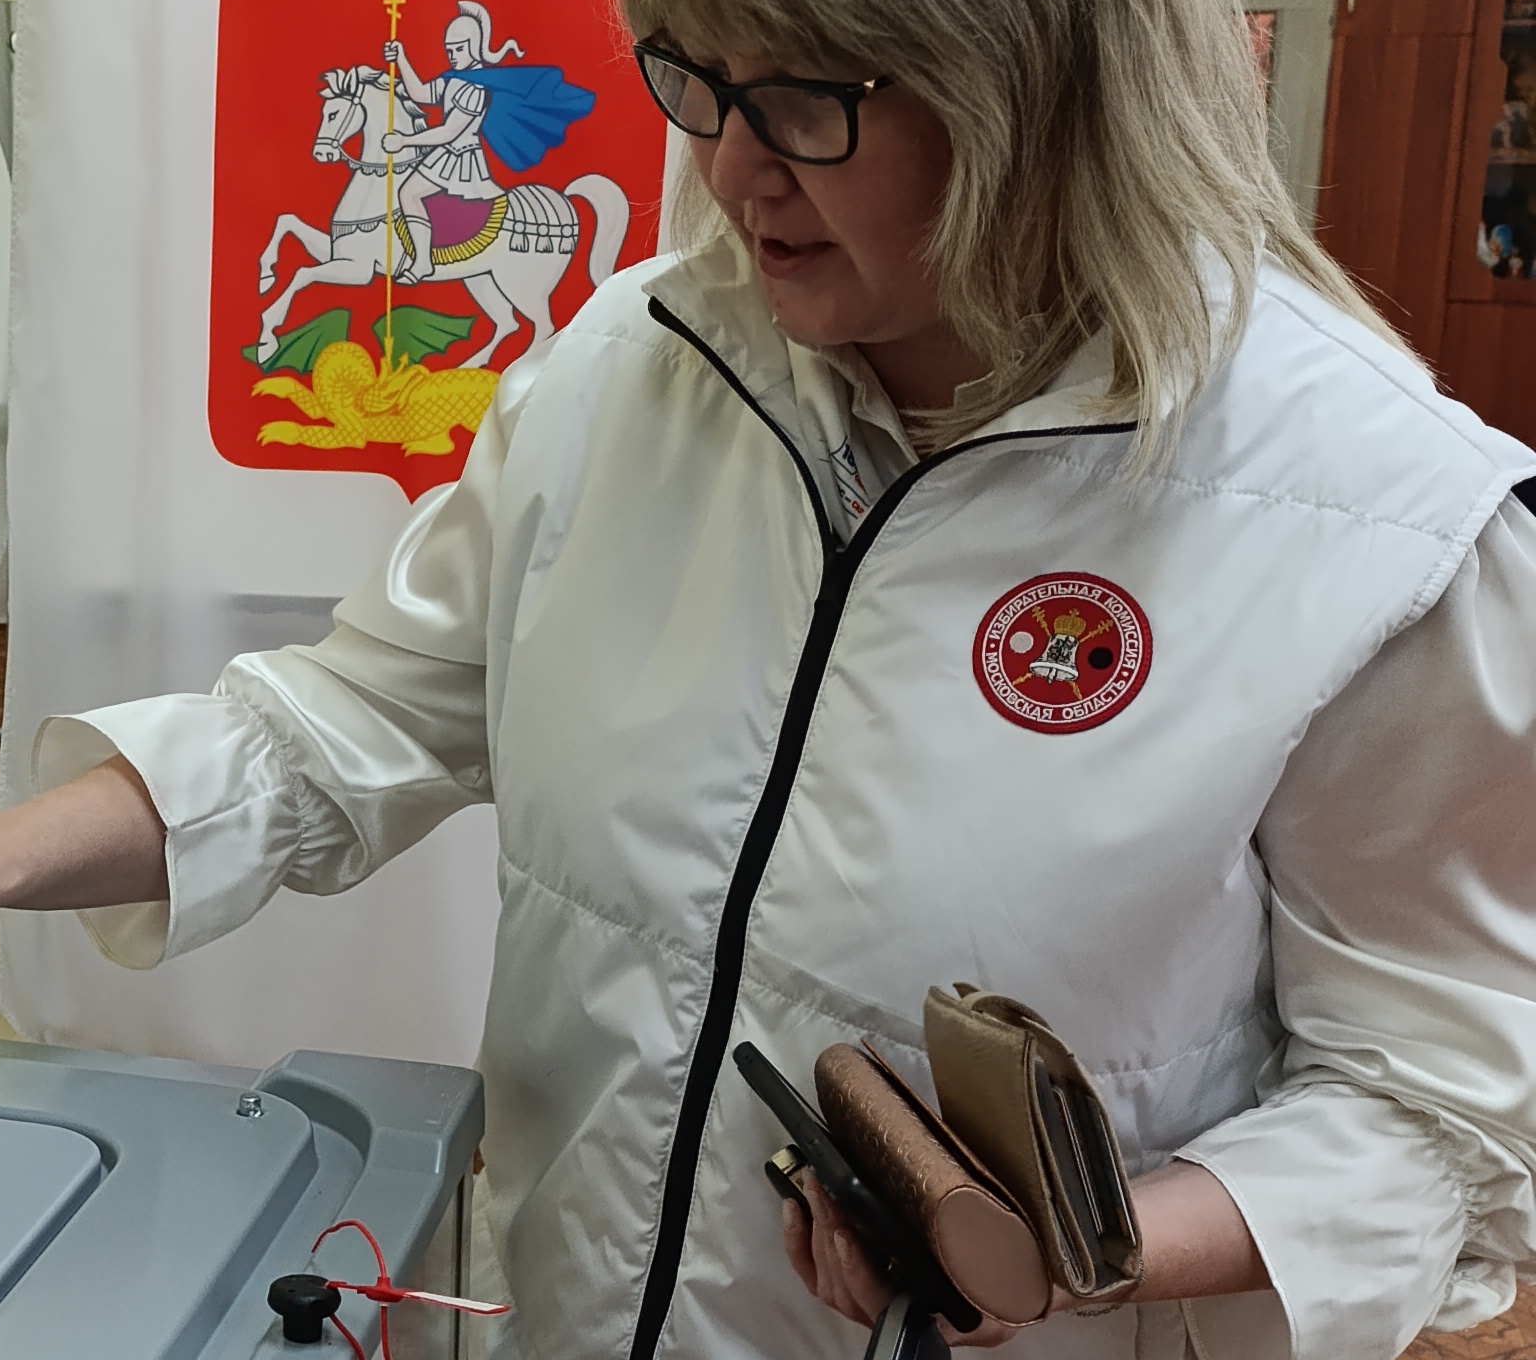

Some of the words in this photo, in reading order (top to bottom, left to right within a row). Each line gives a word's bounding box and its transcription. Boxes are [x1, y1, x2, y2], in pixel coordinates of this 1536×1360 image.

[989, 583, 1102, 641] ИЗБИРАТЕЛЬНАЯ
[1105, 596, 1139, 670] КОМИССИЯ
[985, 651, 1053, 720] МОСКОВСКАЯ
[1062, 680, 1126, 720] ОБЛАСТЬ
